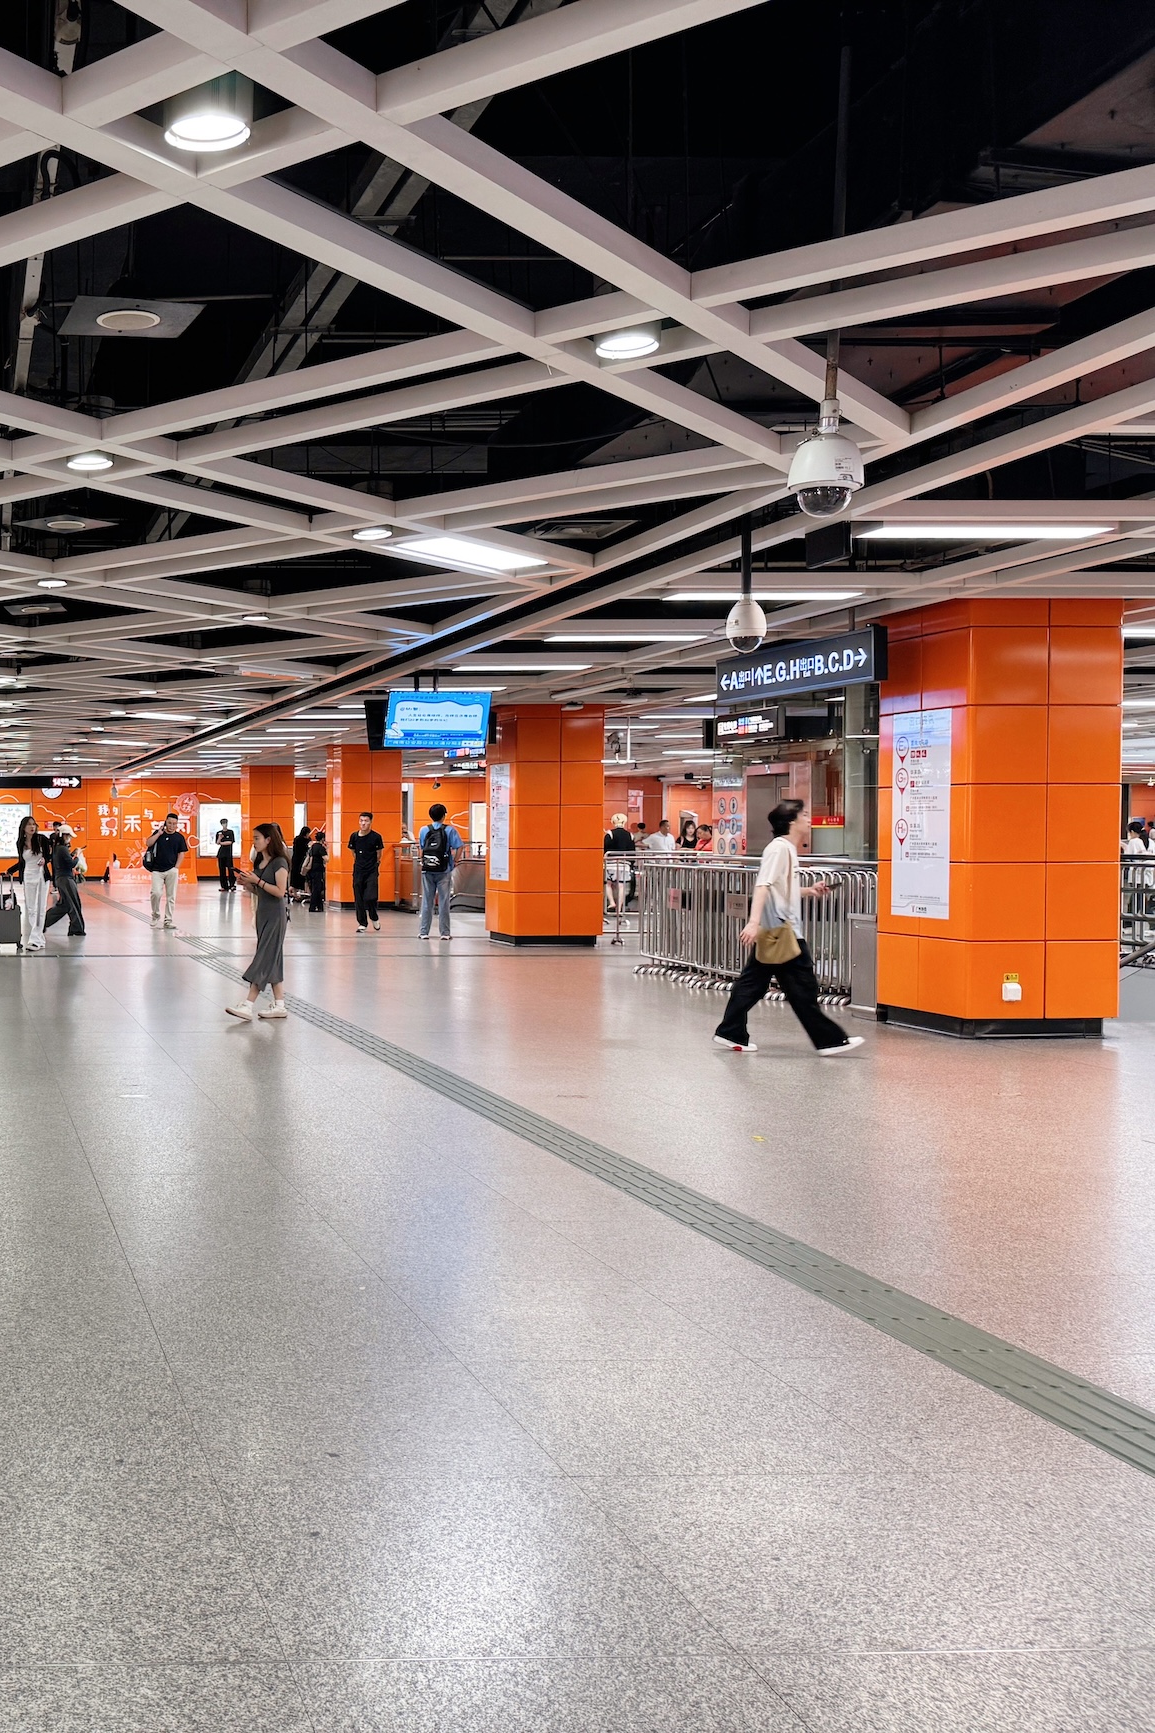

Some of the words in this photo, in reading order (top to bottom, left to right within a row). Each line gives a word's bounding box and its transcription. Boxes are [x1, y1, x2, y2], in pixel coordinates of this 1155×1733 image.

[729, 671, 739, 691] A
[738, 670, 751, 685] 出口
[763, 659, 800, 685] E.G.H
[799, 657, 814, 672] 出口
[814, 648, 854, 676] B.C.D
